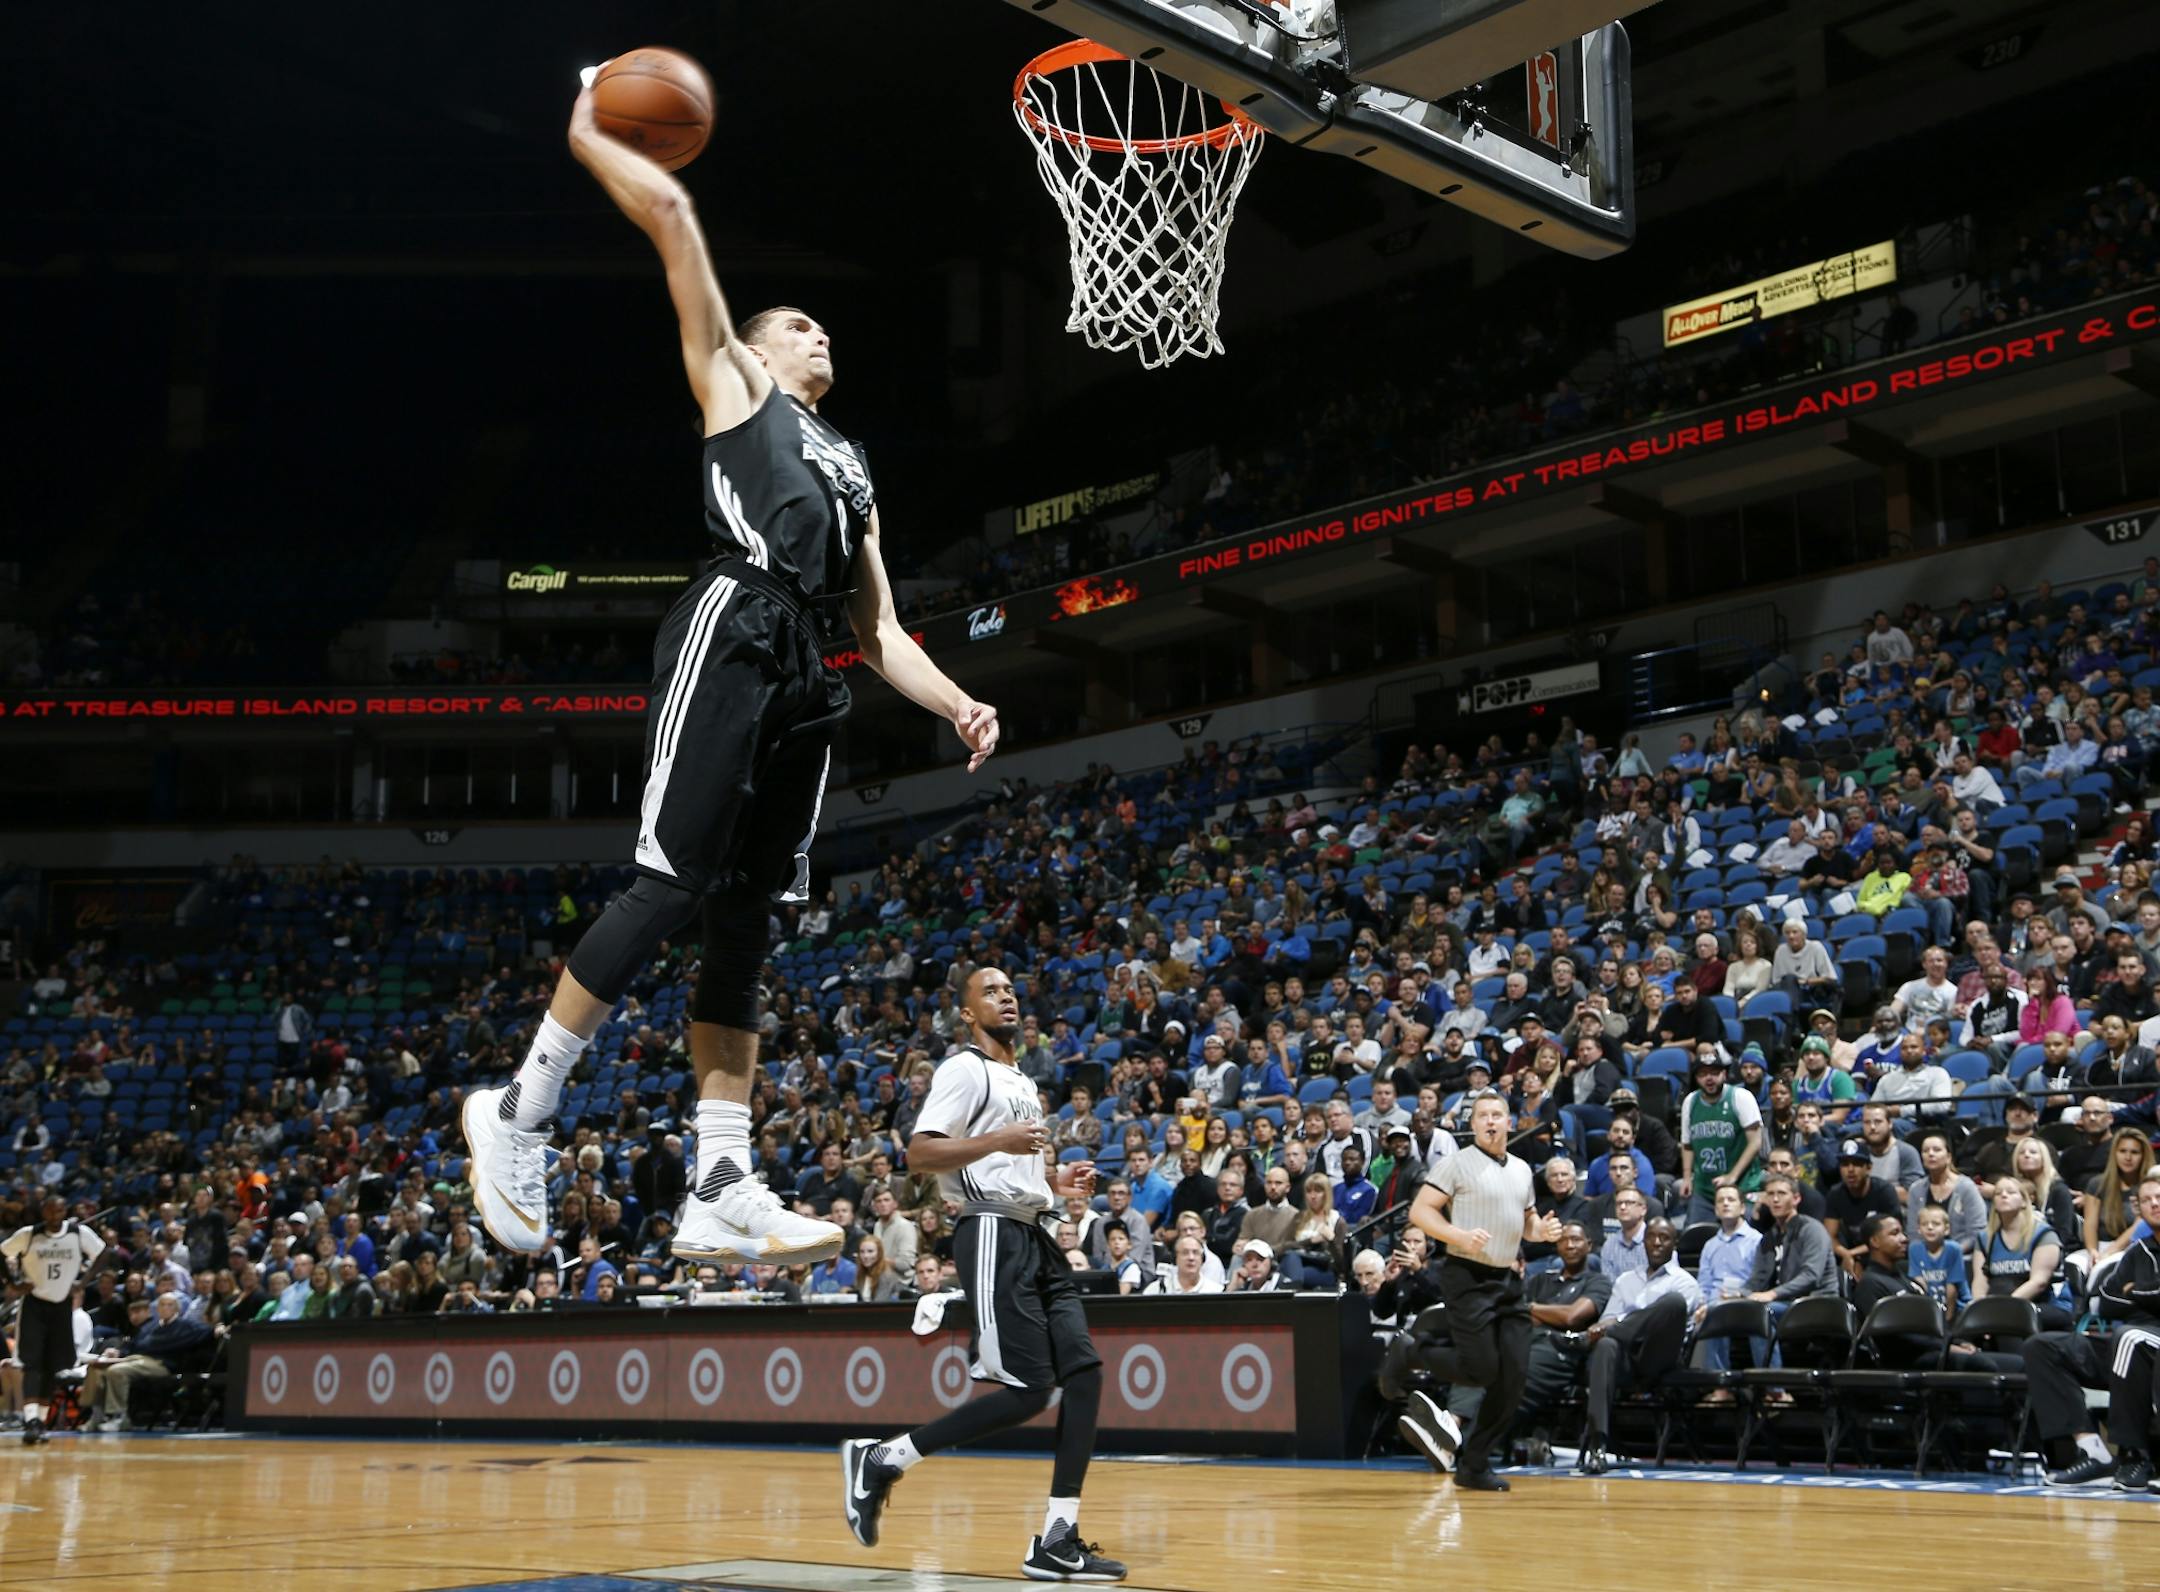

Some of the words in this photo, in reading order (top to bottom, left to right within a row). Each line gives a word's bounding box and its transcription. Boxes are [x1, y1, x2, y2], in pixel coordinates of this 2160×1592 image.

[1829, 258, 1889, 281] SOLTIONS
[1179, 547, 1240, 578] FINE
[1248, 520, 1346, 561] DINING
[1352, 487, 1475, 533] IGNITES
[1482, 472, 1526, 500] AT
[1533, 419, 1725, 485] TREASURE
[1735, 380, 1878, 433] ISLAND
[1889, 328, 2065, 393] RESORT
[2078, 317, 2113, 343] &
[2105, 517, 2141, 541] 131
[506, 570, 569, 594] Cargill
[1476, 677, 1532, 710] POPP
[15, 701, 55, 716] AT
[64, 699, 235, 717] TREASURE
[243, 699, 358, 716] ISLAND
[366, 697, 491, 714] RESORT
[499, 697, 523, 713] &
[1180, 718, 1202, 736] 129
[424, 830, 448, 844] 126
[1700, 1147, 1727, 1172] 21
[48, 1264, 61, 1280] 15
